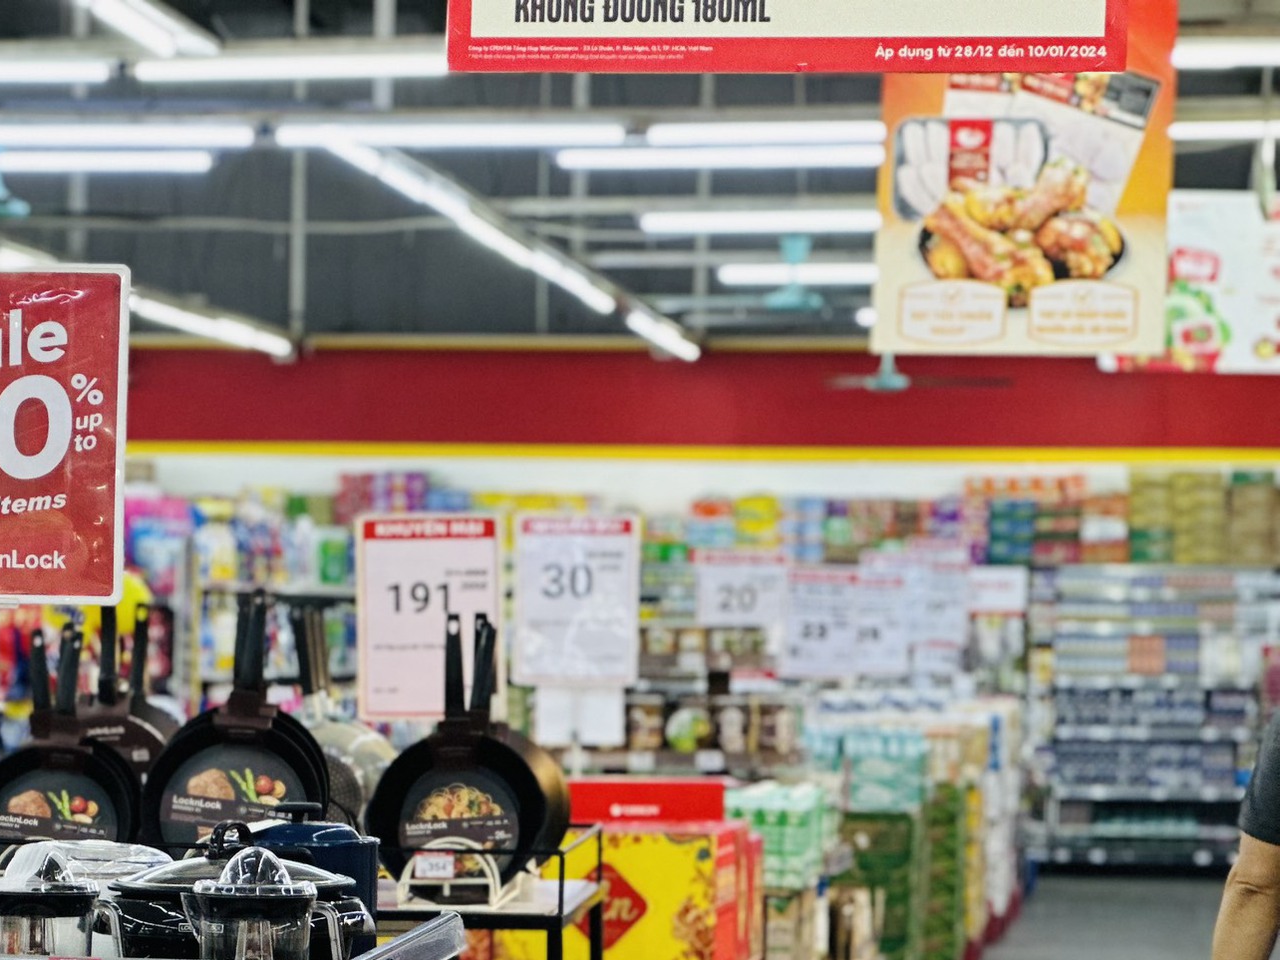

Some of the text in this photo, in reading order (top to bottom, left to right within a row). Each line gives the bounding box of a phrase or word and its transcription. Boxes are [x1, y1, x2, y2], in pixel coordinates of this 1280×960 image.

[694, 0, 770, 23] 180ML
[875, 42, 894, 60] Áp
[898, 45, 933, 61] dụng
[954, 45, 994, 58] 28/12
[998, 43, 1024, 58] đến
[1028, 44, 1108, 58] 10/01/2024
[71, 373, 104, 405] %
[75, 412, 103, 434] up
[74, 434, 98, 452] to
[542, 563, 593, 599] 30
[387, 581, 449, 614] 191
